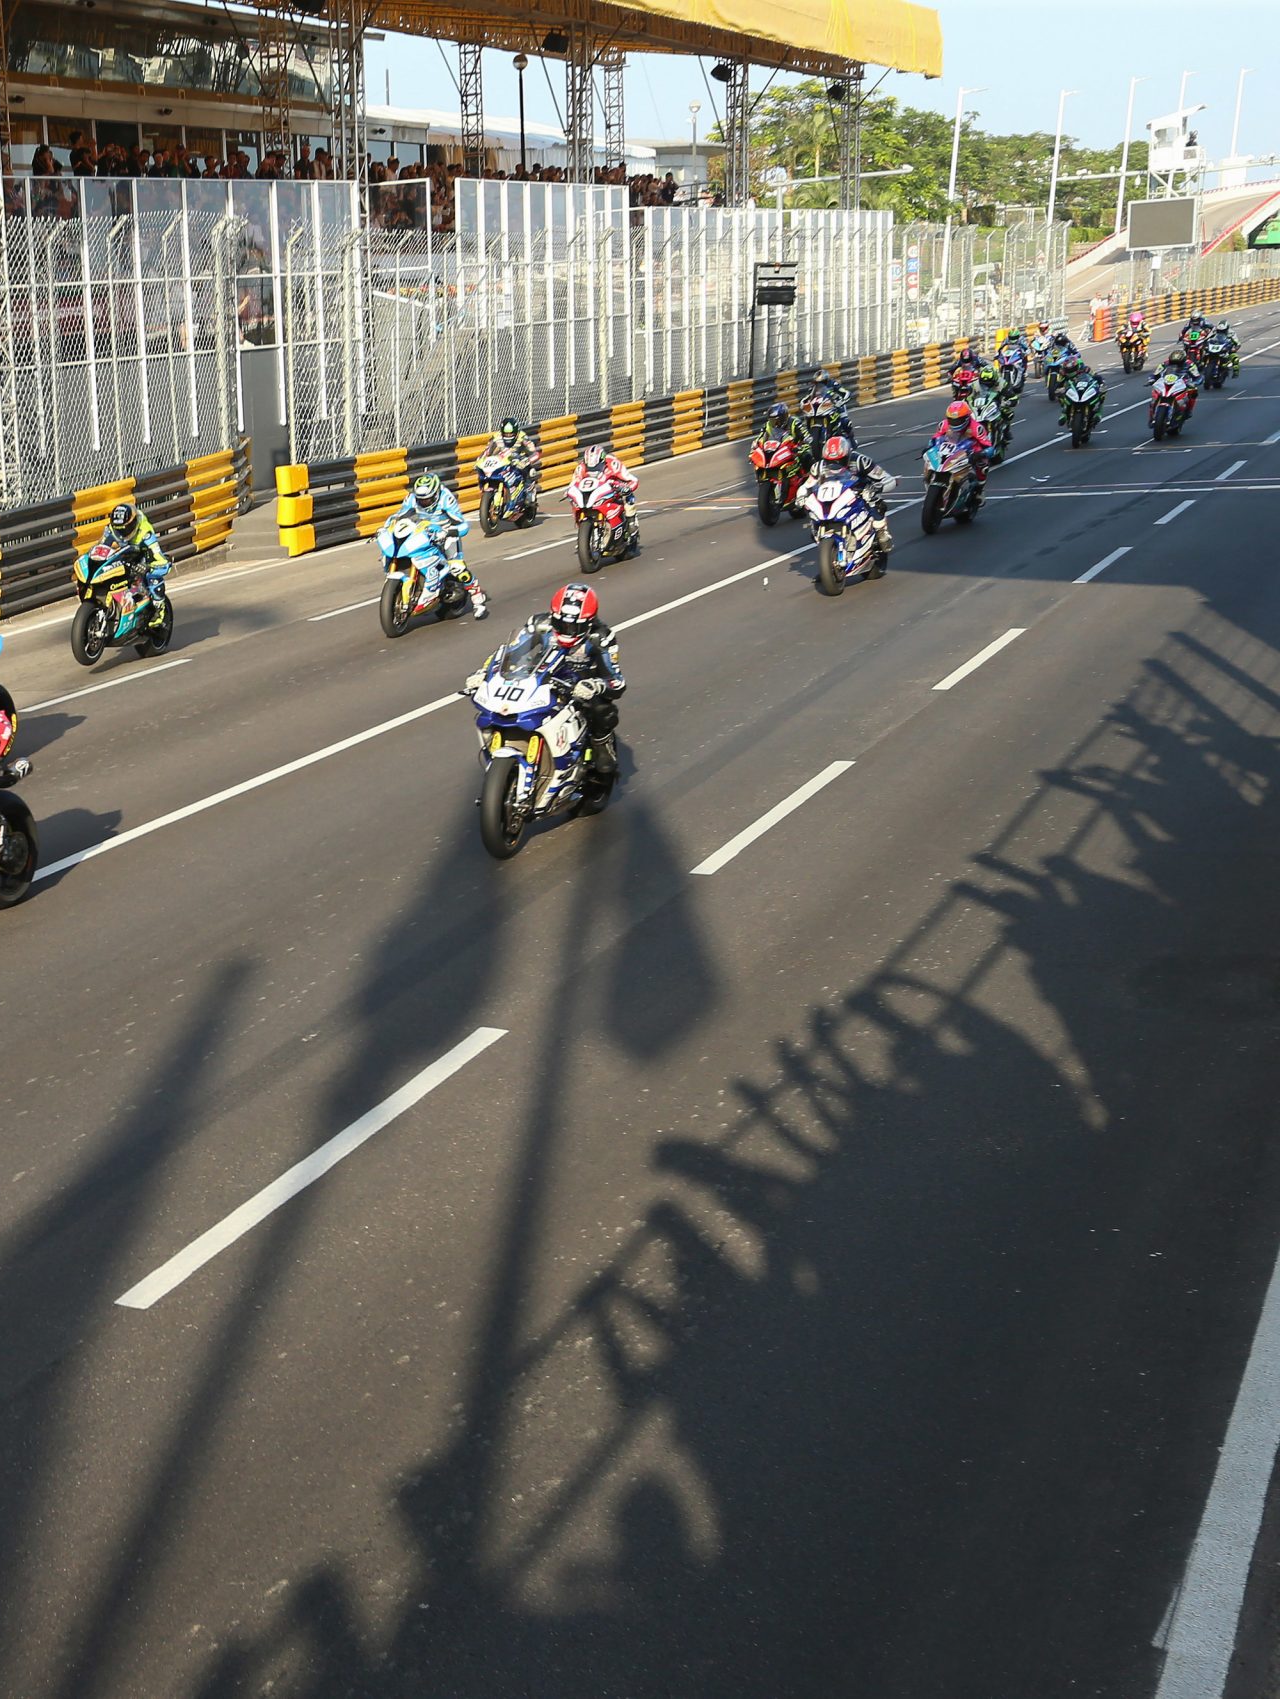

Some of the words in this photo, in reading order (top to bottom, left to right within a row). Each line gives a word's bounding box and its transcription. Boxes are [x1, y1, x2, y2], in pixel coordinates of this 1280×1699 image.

[939, 443, 956, 454] 74
[821, 487, 835, 501] 71
[399, 524, 408, 532] 7
[494, 687, 525, 702] 40
